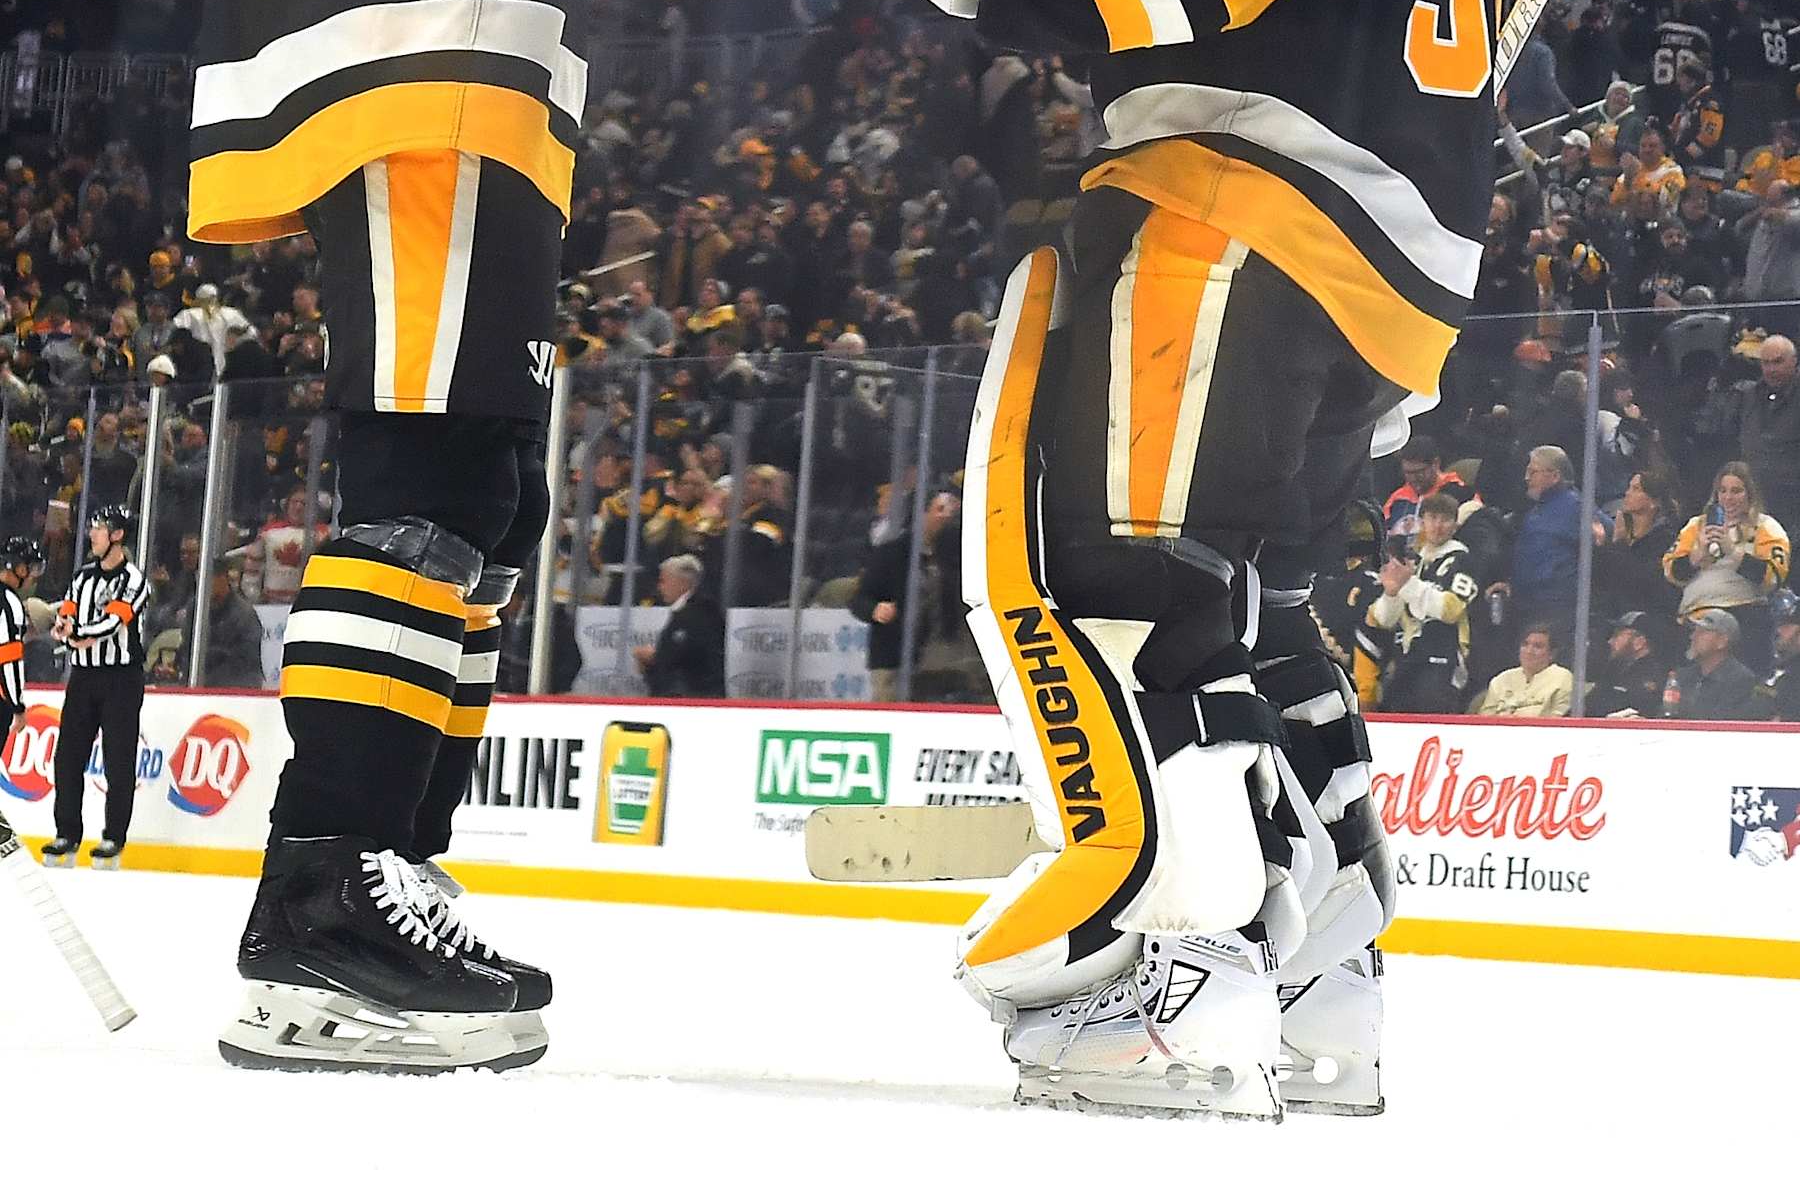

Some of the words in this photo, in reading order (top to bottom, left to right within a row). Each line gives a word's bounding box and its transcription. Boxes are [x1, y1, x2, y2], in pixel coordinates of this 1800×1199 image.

[1003, 606, 1107, 844] VAUGHN
[178, 736, 240, 800] DQ
[760, 738, 881, 800] MSA
[914, 748, 985, 783] EVERY
[1397, 853, 1419, 886] &
[1426, 852, 1497, 889] Draft
[1504, 856, 1591, 894] House
